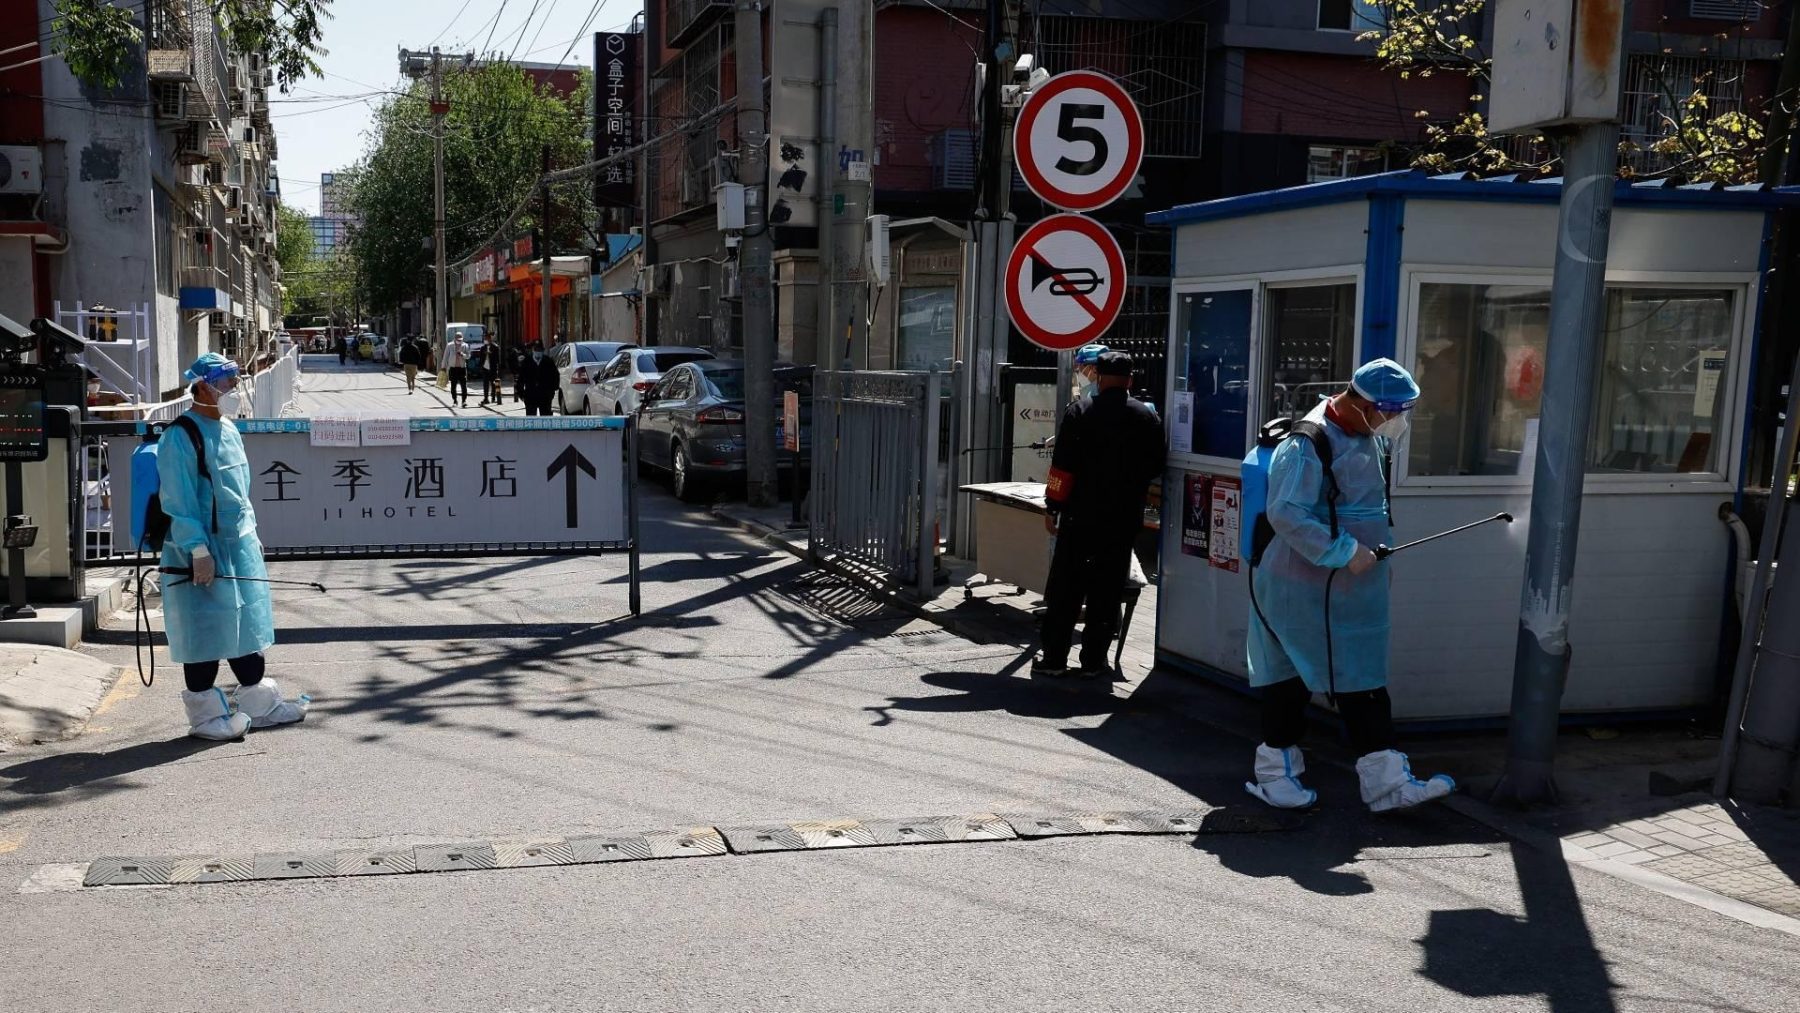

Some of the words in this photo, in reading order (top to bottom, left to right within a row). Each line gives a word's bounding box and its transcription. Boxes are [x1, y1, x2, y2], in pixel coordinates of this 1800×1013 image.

[1054, 102, 1109, 176] 5
[259, 456, 518, 502] 全季酒店
[323, 508, 342, 521] JI
[361, 506, 457, 519] HOTEL
